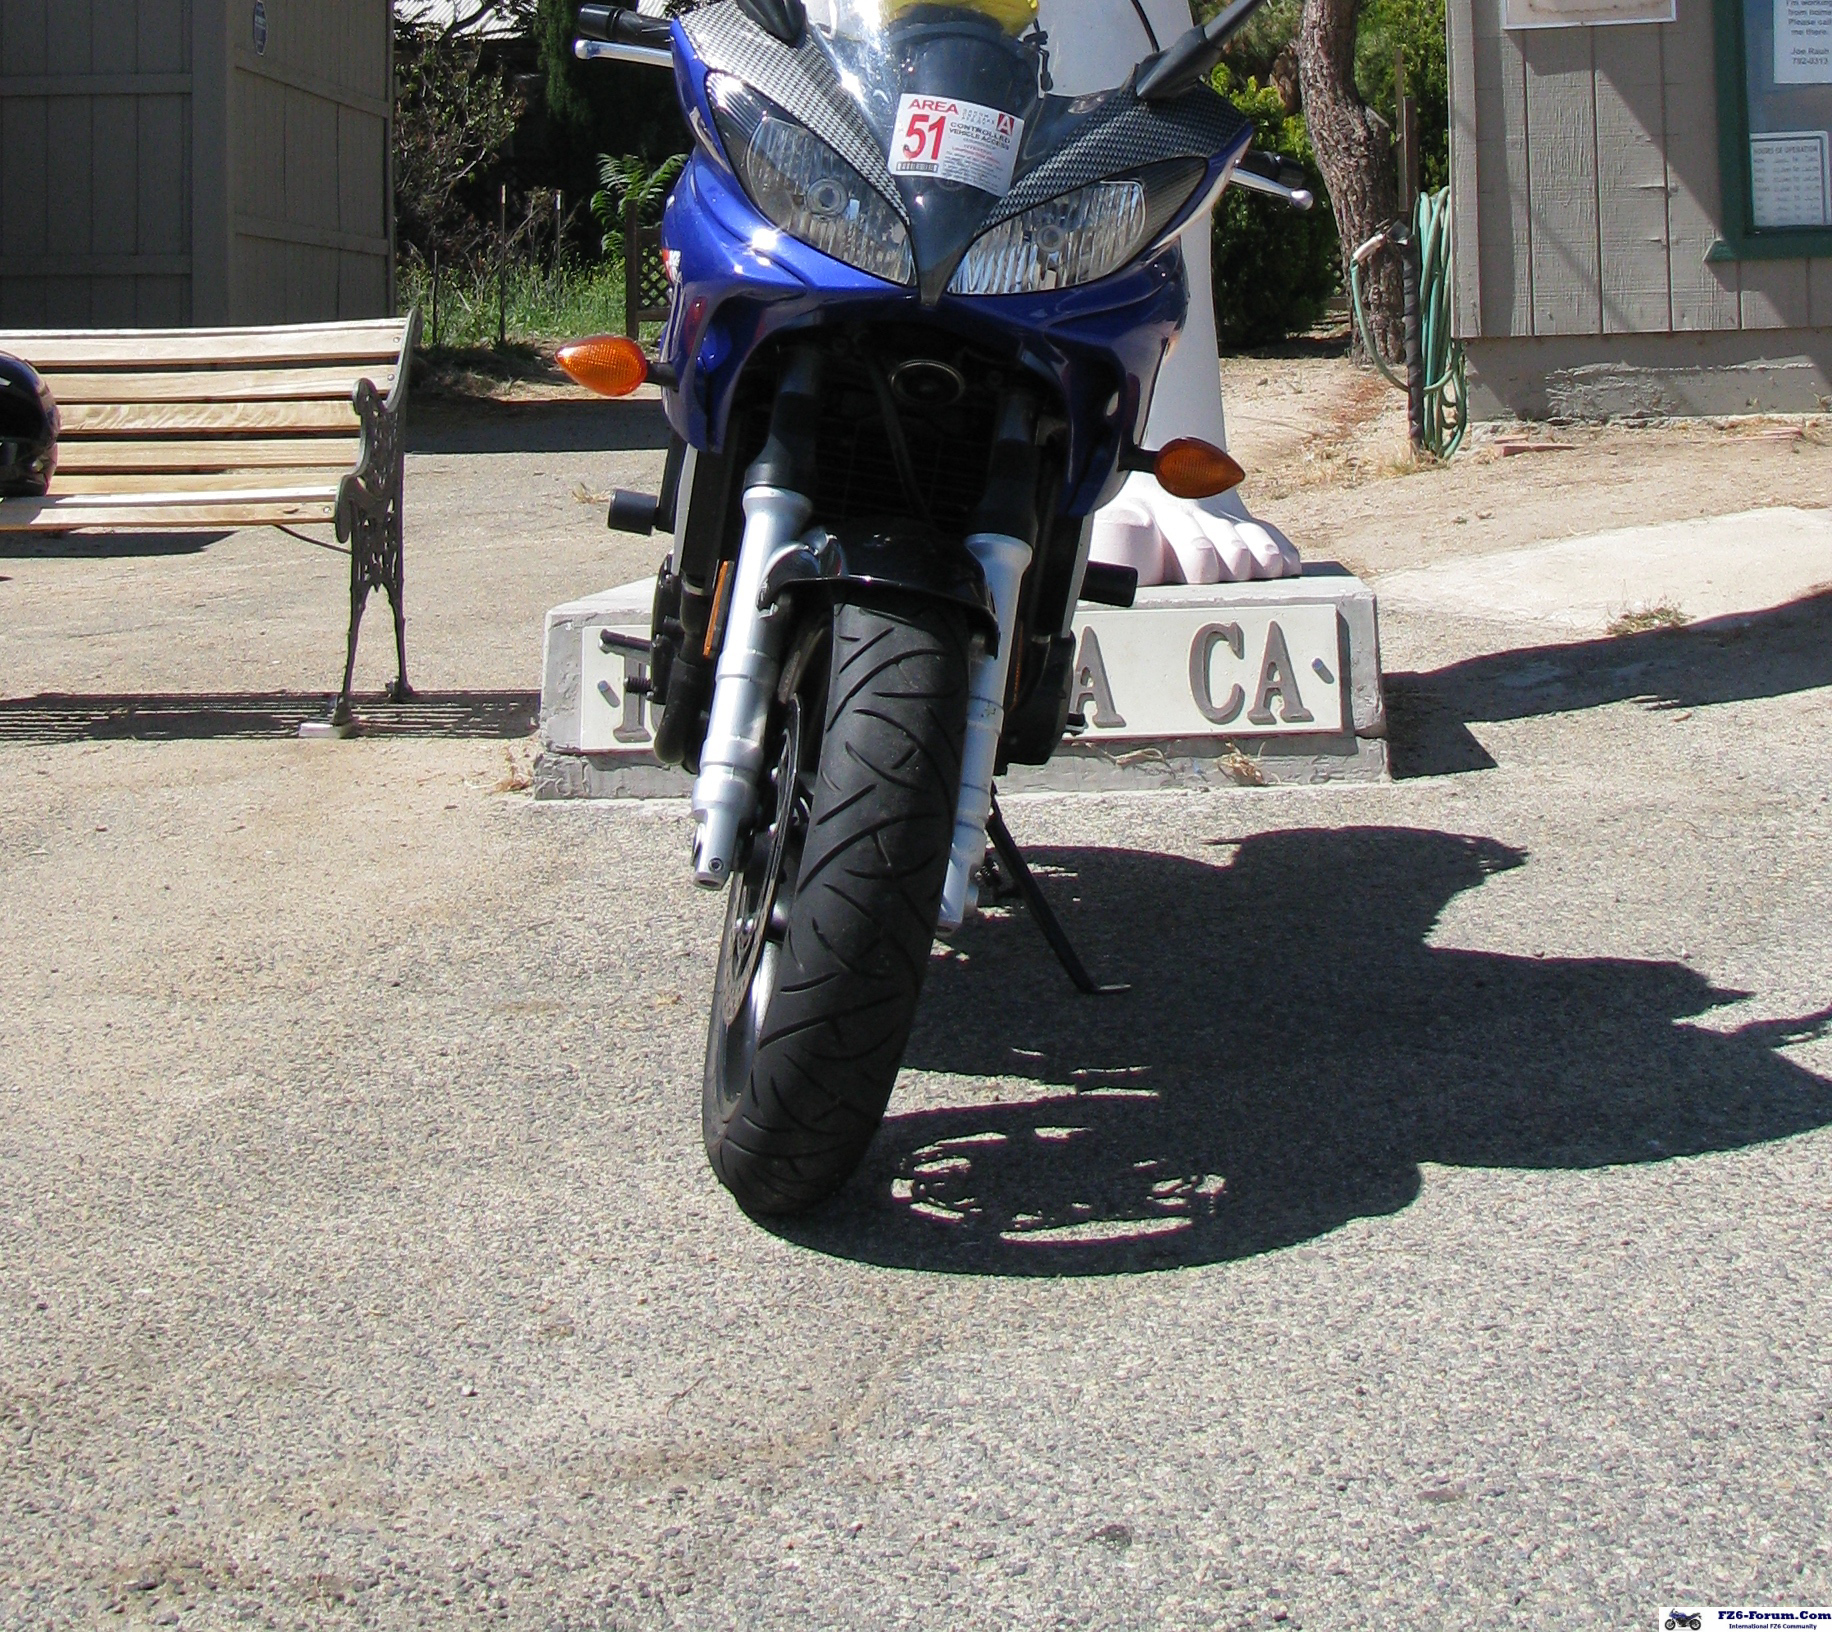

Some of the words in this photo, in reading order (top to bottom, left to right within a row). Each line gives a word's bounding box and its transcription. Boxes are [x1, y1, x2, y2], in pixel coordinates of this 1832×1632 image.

[1788, 17, 1816, 25] Please
[1790, 47, 1806, 55] Joe
[908, 99, 959, 115] AREA
[903, 114, 947, 160] 51
[949, 128, 980, 140] VEHICLE
[981, 135, 1010, 151] ACCESS
[950, 121, 1011, 144] CONTROLLED
[1189, 620, 1315, 726] CA
